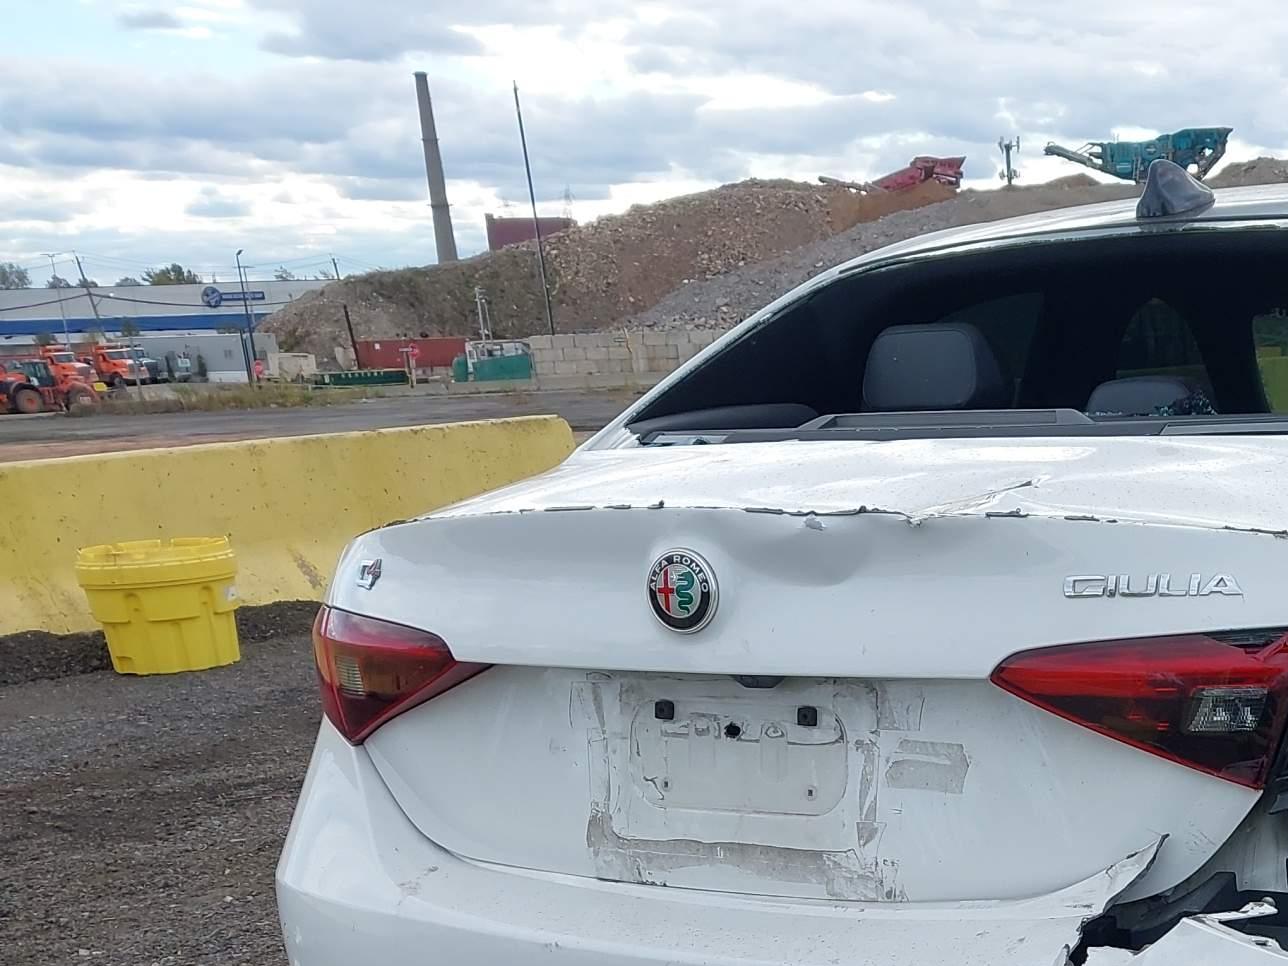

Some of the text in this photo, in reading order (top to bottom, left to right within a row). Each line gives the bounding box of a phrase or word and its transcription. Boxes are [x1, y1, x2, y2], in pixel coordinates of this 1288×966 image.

[649, 555, 709, 593] ALFA ROMEO
[1063, 573, 1244, 598] GIULIA
